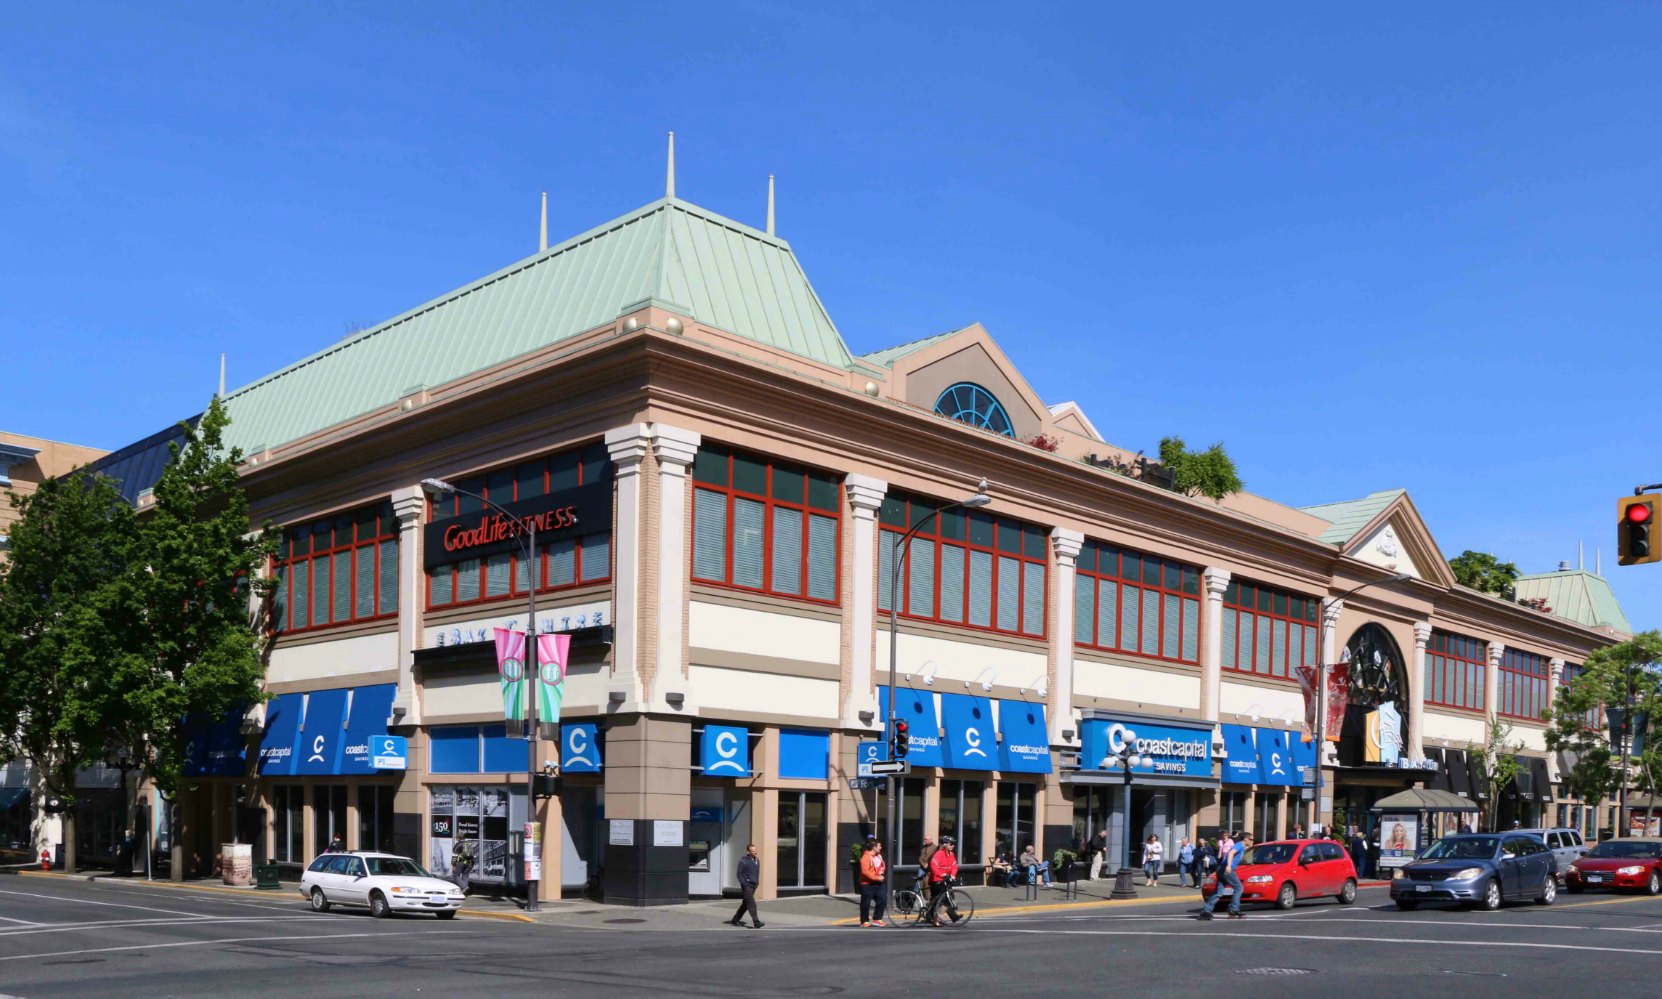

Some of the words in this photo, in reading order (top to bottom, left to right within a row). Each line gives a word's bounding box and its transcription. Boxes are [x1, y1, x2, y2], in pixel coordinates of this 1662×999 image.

[444, 512, 507, 551] GoodLife
[510, 506, 573, 536] FITNESS
[346, 744, 368, 754] coastca
[1010, 744, 1048, 755] coastcapital
[1136, 737, 1207, 761] coastcapital
[1156, 762, 1186, 772] SAVINGS
[435, 822, 448, 833] 150
